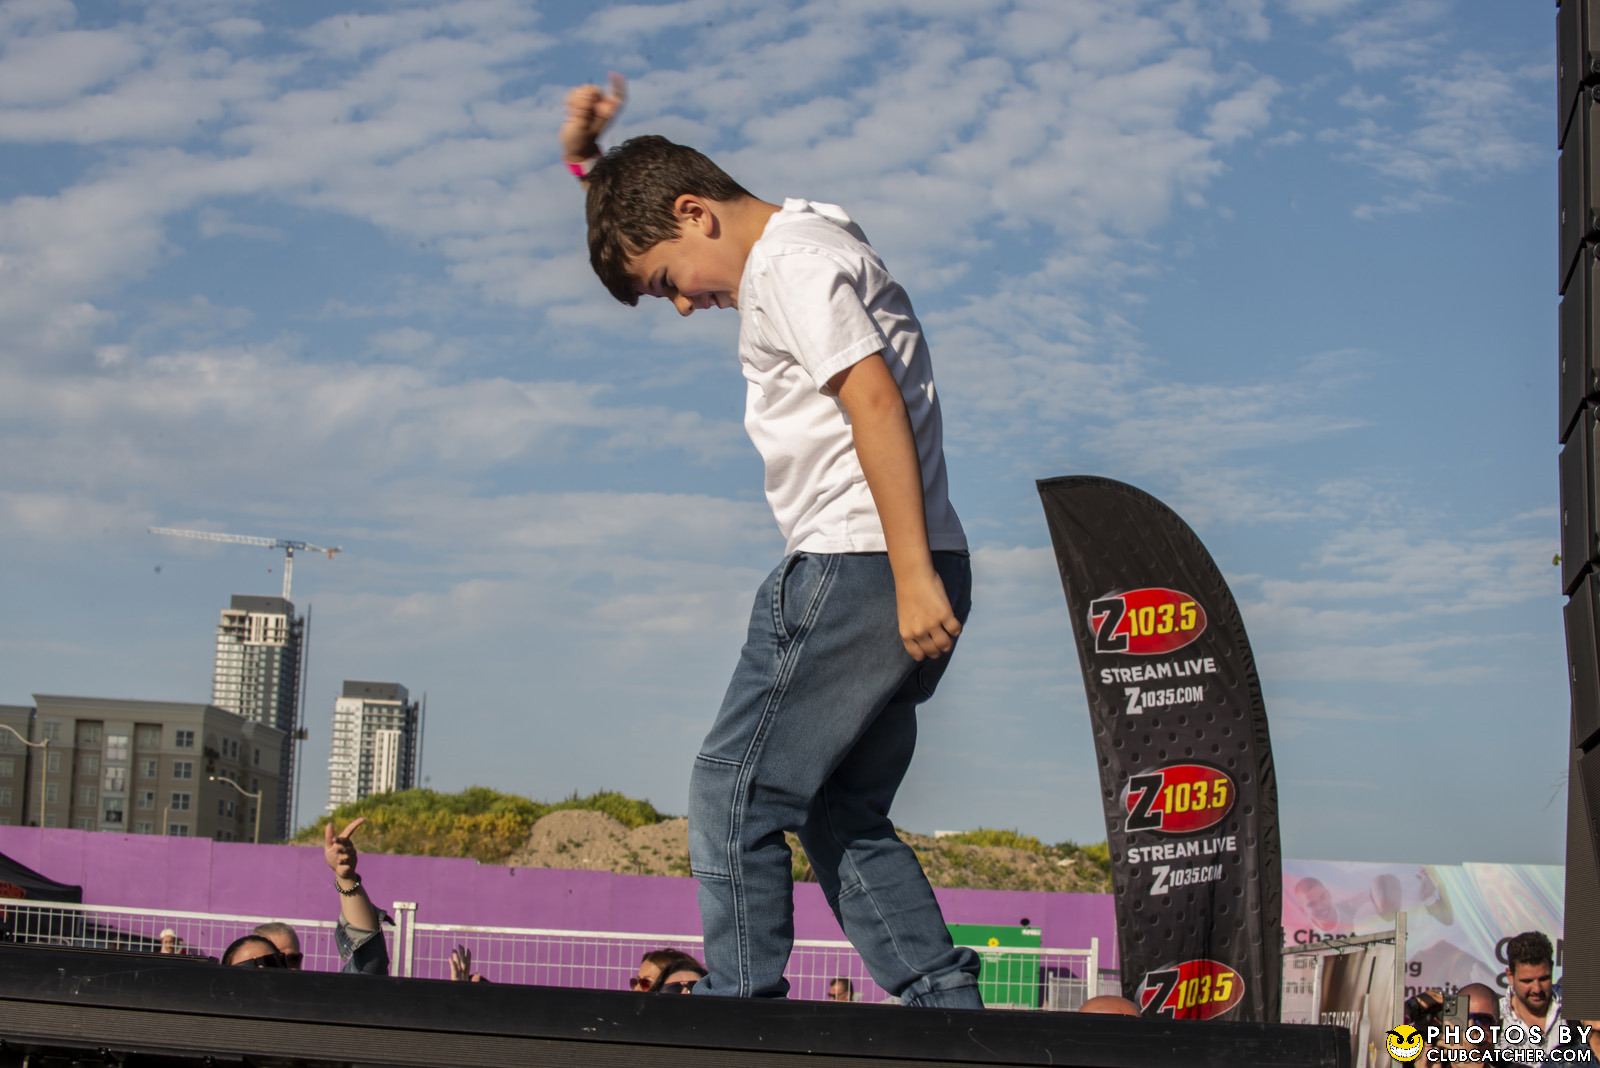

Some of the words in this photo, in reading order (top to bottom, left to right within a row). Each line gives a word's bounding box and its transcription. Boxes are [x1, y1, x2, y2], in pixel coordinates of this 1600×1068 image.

[1100, 663, 1172, 685] STREAM
[1175, 657, 1217, 676] LIVE
[1124, 685, 1204, 715] Z1035.COM
[1127, 841, 1200, 865] STREAM
[1203, 836, 1237, 855] LIVE
[1149, 863, 1223, 896] Z1035.COM
